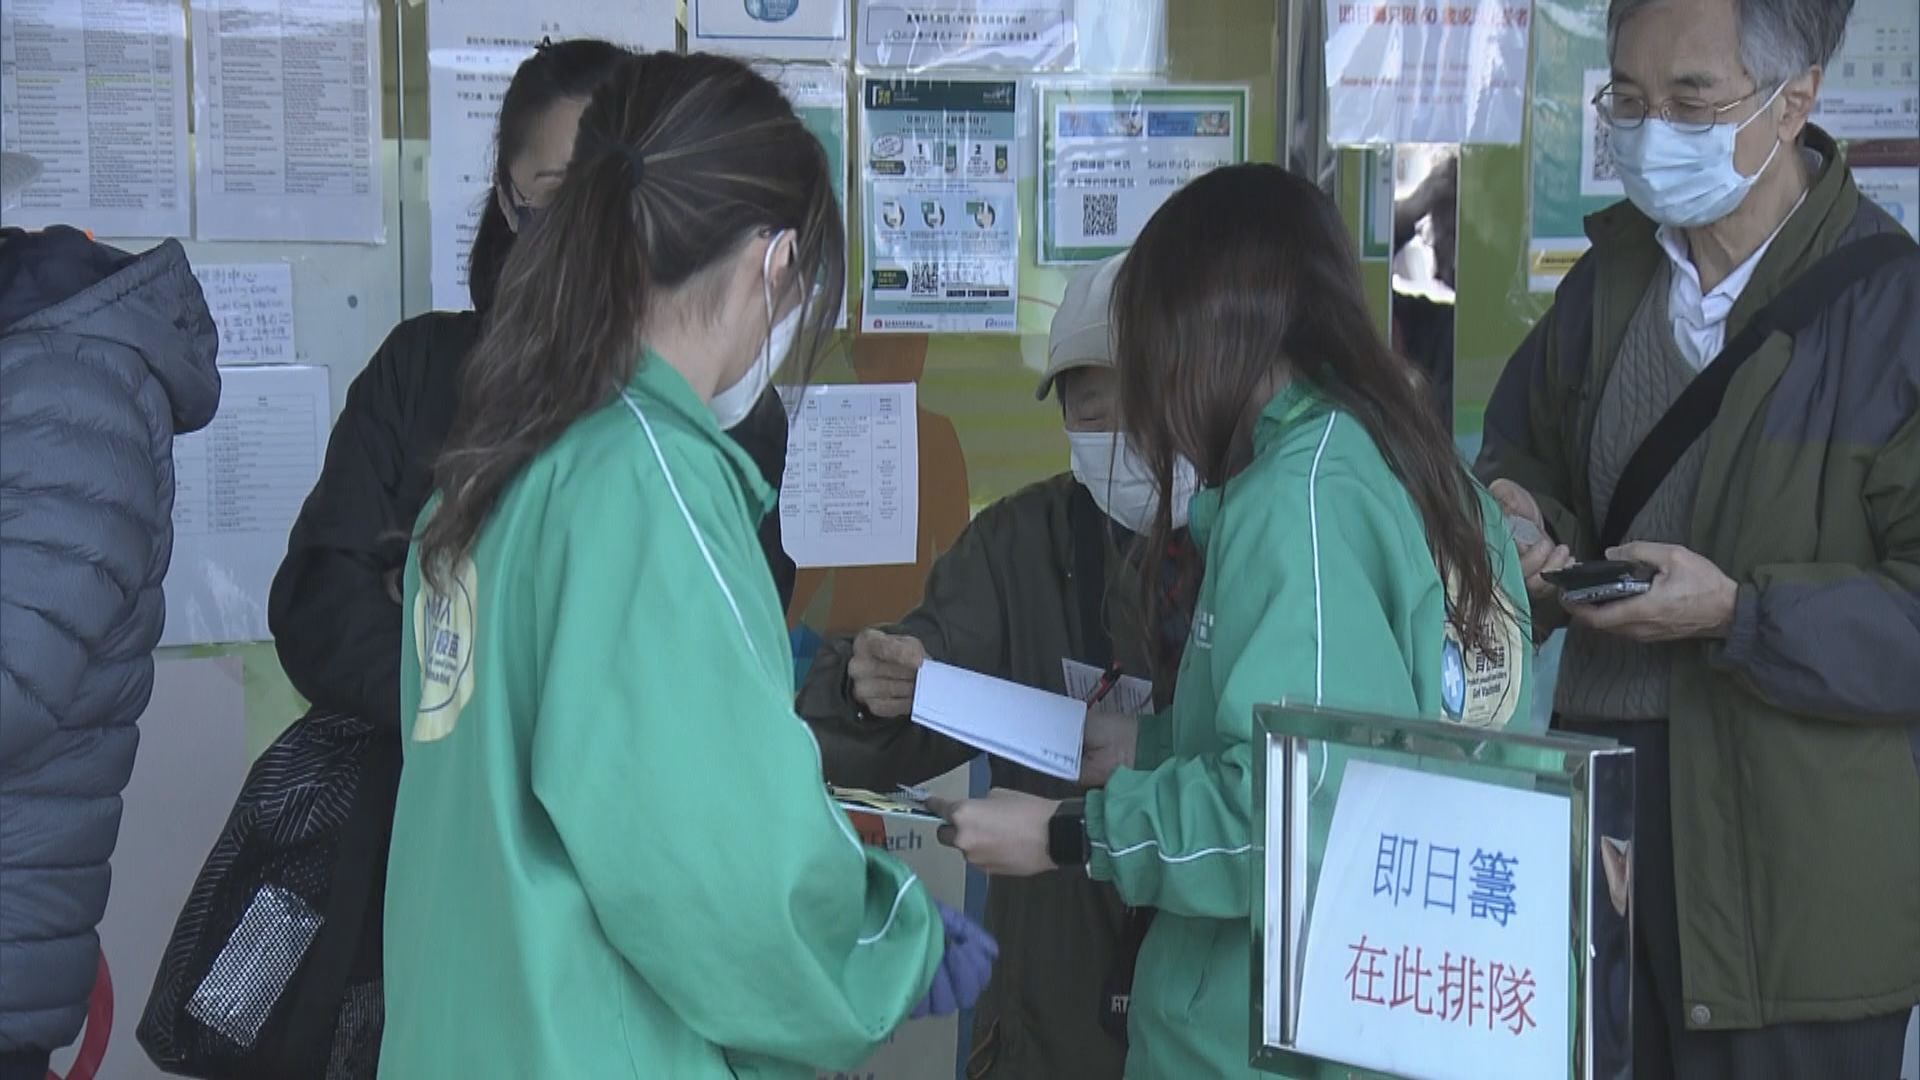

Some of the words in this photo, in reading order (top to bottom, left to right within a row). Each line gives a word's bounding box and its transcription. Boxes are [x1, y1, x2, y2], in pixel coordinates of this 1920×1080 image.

[1371, 832, 1520, 928] 即日籌
[1344, 934, 1538, 1036] 在此排隊
